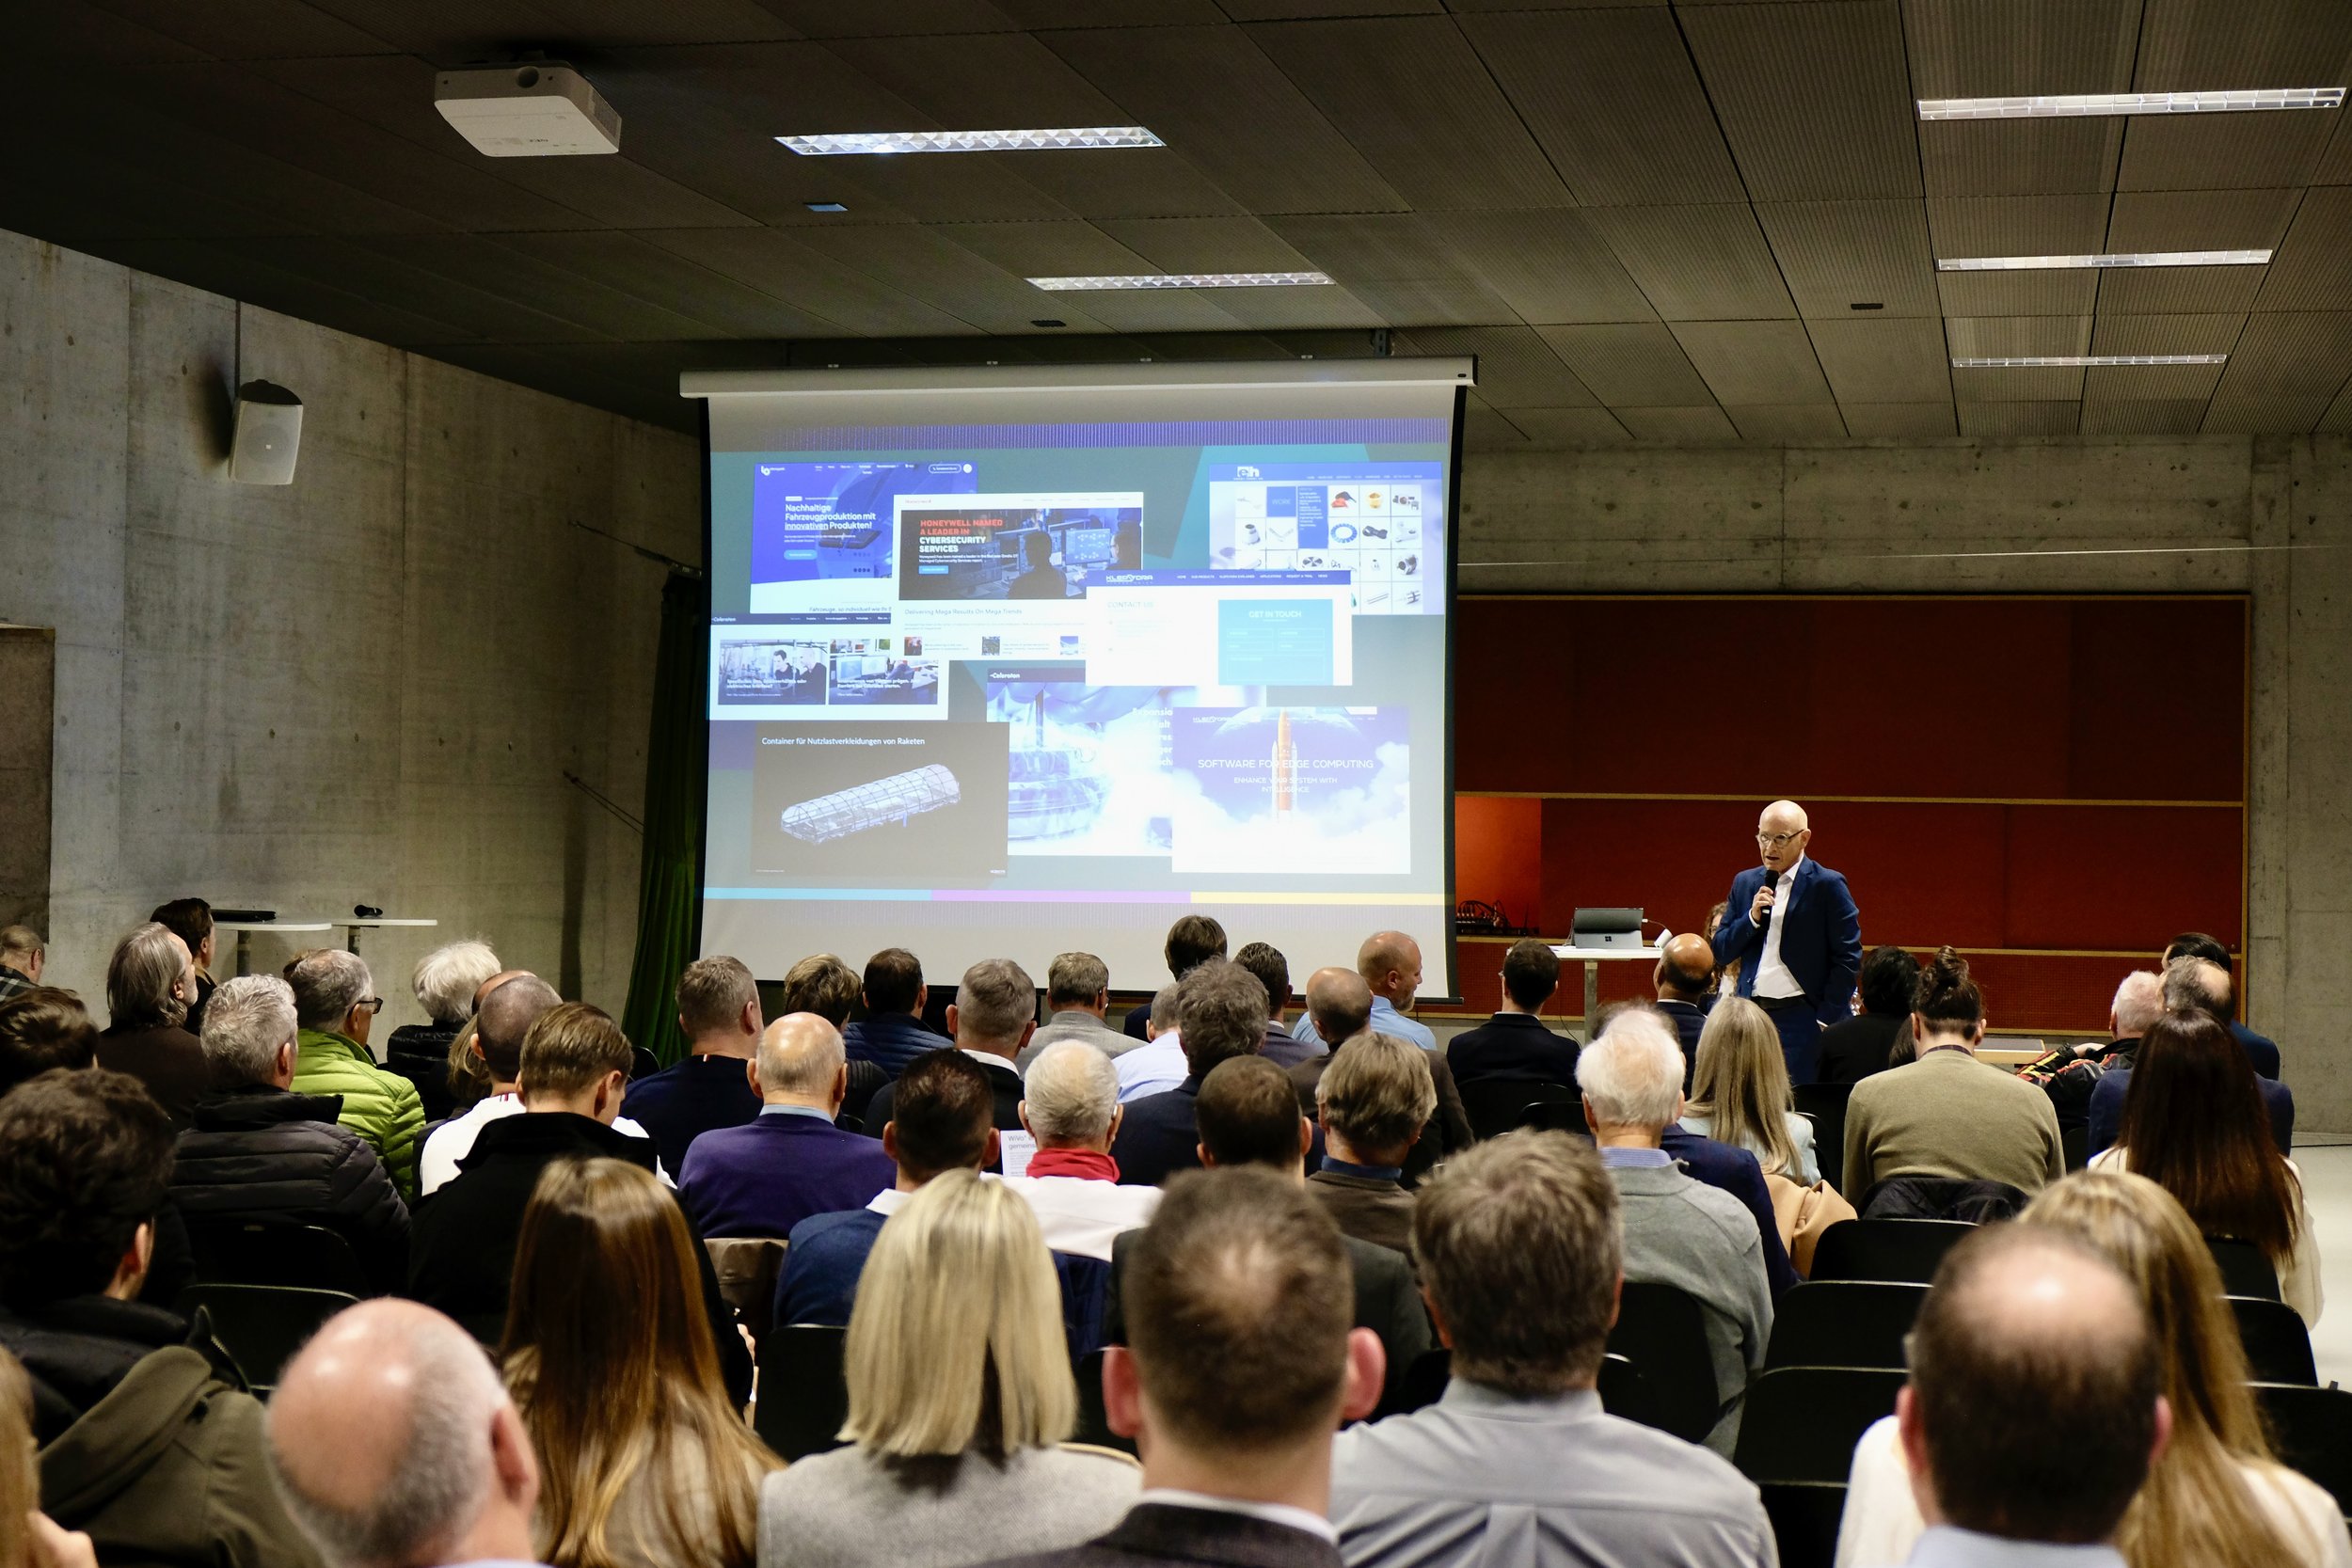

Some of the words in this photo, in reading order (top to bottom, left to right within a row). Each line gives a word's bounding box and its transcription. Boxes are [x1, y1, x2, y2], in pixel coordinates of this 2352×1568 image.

[785, 504, 832, 514] Nachhaltige
[785, 513, 863, 522] Fahrzeugproduktion
[863, 512, 876, 520] mit
[829, 521, 872, 530] Produkten!
[973, 518, 1003, 527] NAMED
[919, 535, 986, 544] CYBERSECURITY
[919, 545, 959, 553] SERVICES
[1265, 610, 1274, 618] IN
[1276, 610, 1302, 618] TOUCH
[761, 736, 795, 745] Container
[795, 736, 806, 745] für
[807, 736, 882, 746] Nutzlastverkleidungen
[897, 736, 926, 745] Raketen
[1198, 759, 1256, 768] SOFTWARE
[1259, 759, 1279, 768] FOR
[1281, 759, 1310, 768] EDGE
[1312, 759, 1374, 768] COMPUTING
